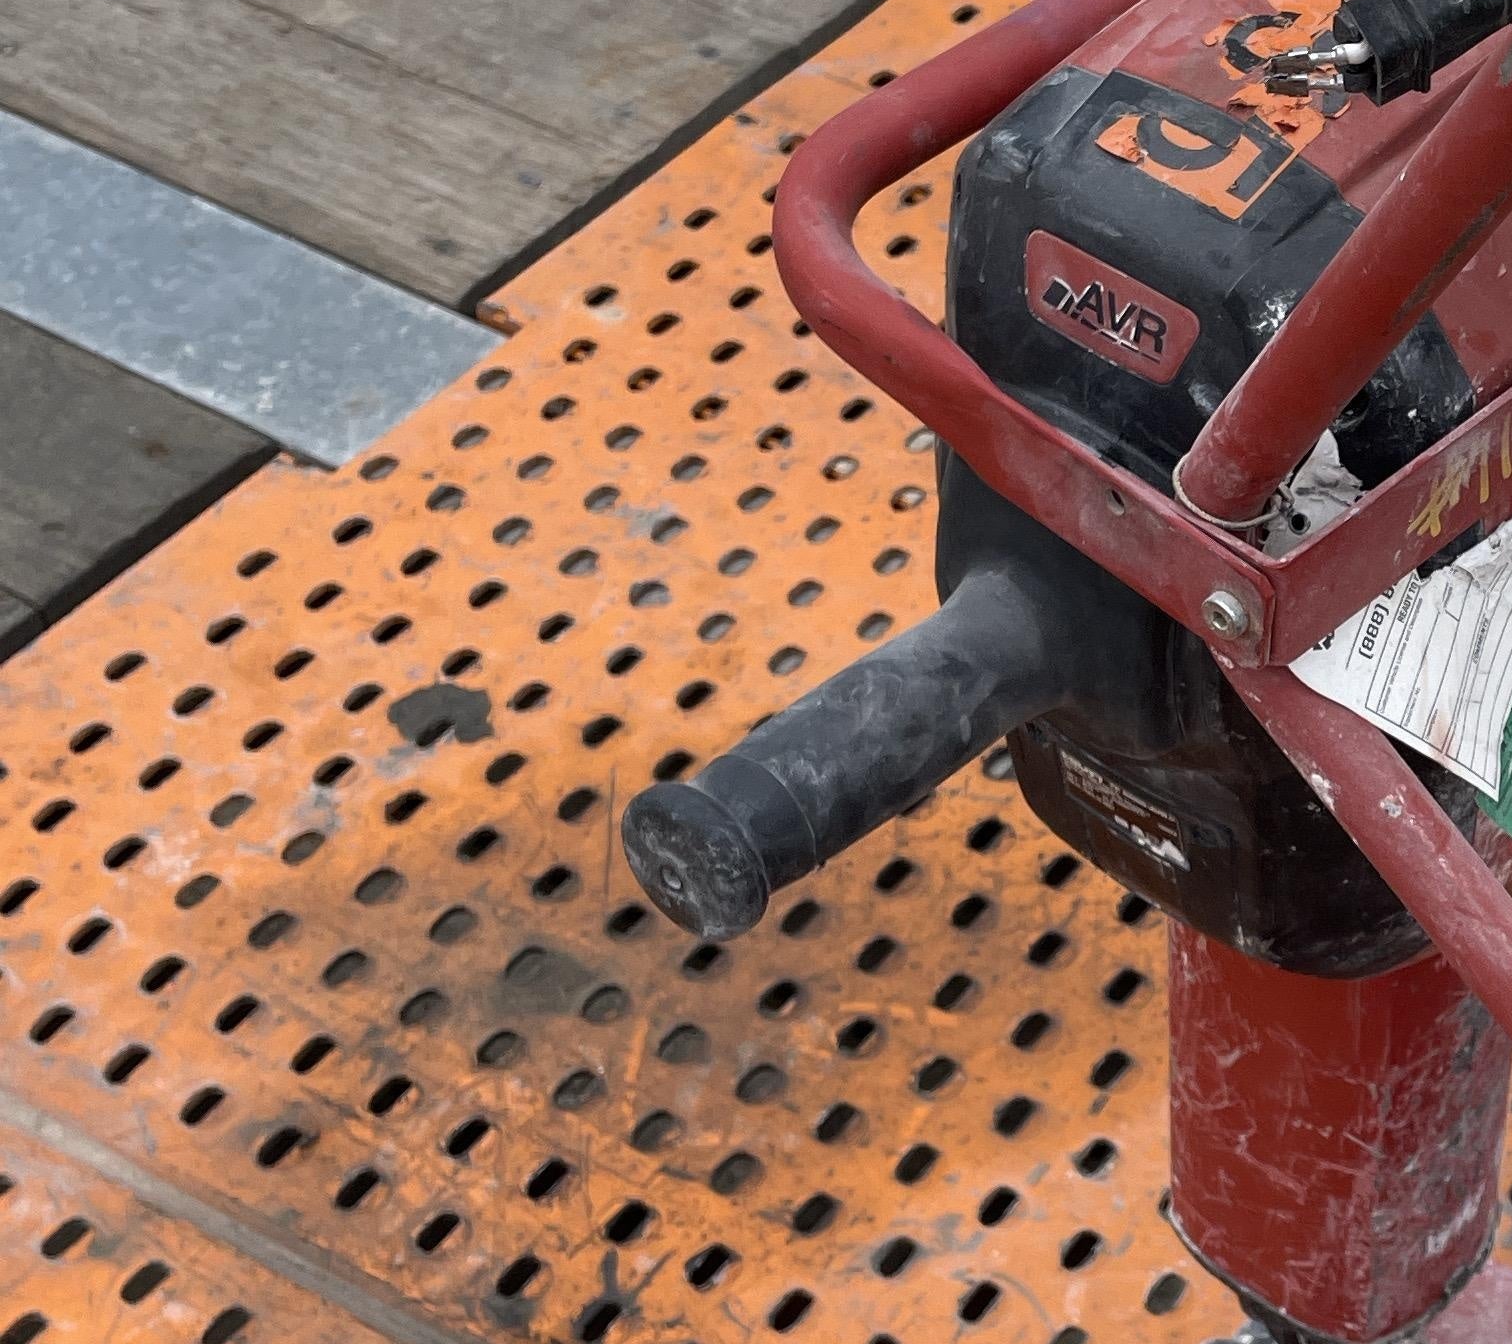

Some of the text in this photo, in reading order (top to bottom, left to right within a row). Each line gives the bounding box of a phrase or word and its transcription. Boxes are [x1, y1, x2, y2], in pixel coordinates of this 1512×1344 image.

[1076, 281, 1167, 354] AVR
[1358, 603, 1390, 660] (888)
[1397, 595, 1413, 624] READY
